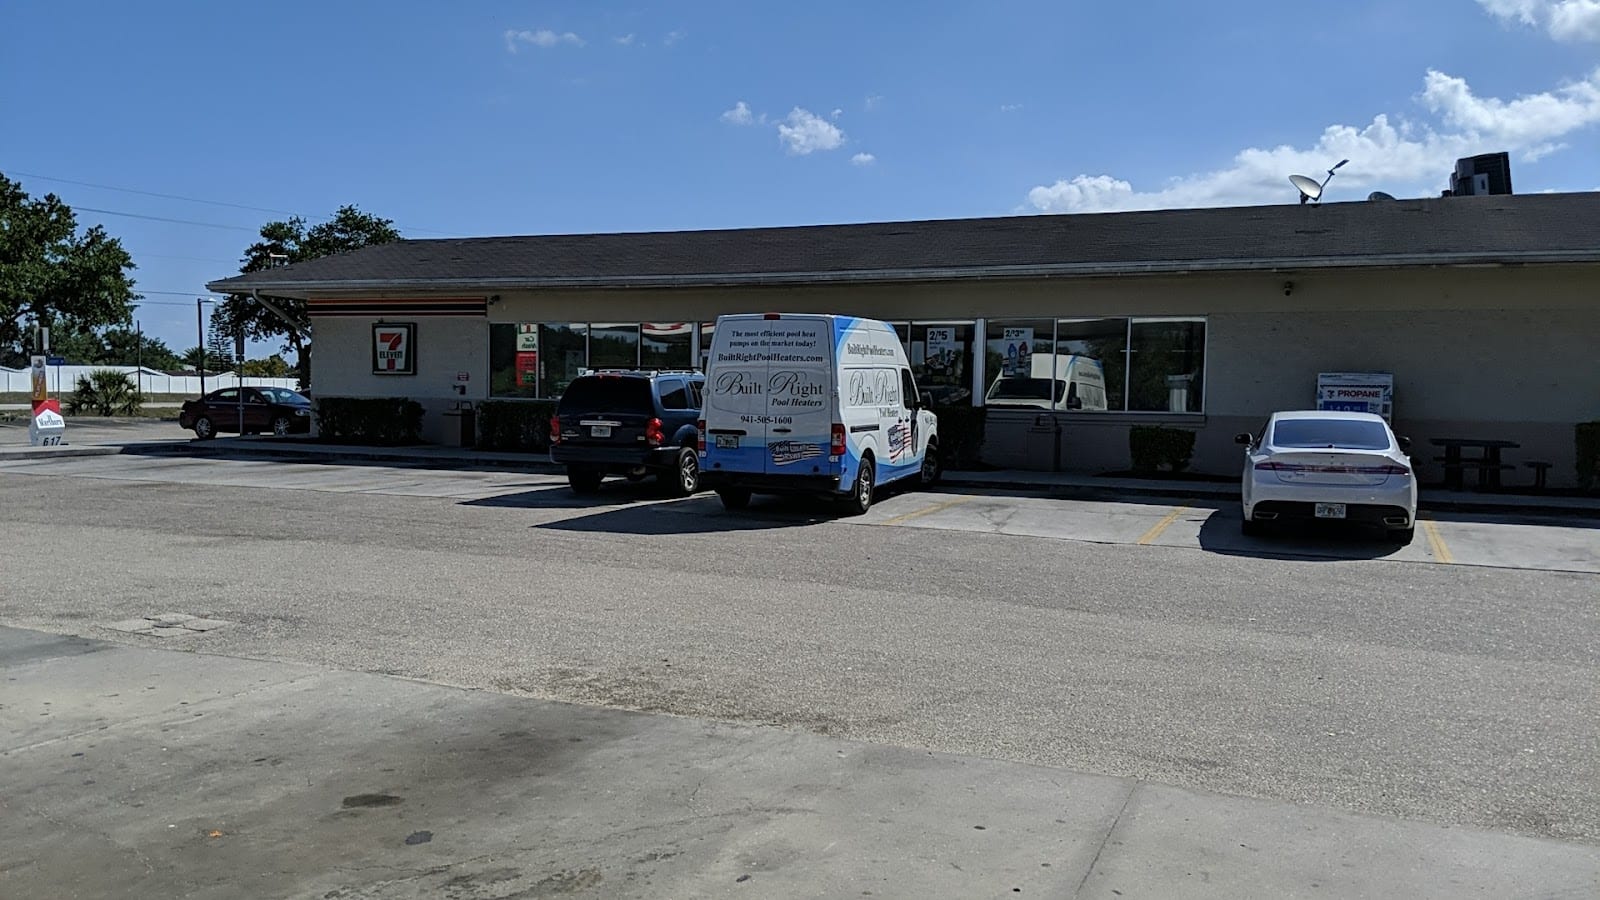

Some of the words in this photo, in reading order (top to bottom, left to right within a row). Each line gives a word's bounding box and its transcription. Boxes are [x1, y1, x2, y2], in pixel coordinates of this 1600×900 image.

[786, 330, 801, 338] pool
[380, 332, 402, 351] 7
[795, 340, 816, 348] today!
[379, 351, 403, 359] ELEVEN
[718, 353, 823, 362] BuiltRightPoolHeaters.com
[715, 371, 763, 395] Built
[768, 371, 823, 398] Right
[849, 371, 874, 406] Built
[1337, 390, 1381, 398] PROPANE
[771, 398, 789, 406] Pool
[790, 399, 823, 407] Heaters
[740, 415, 793, 425] 941-505-1600
